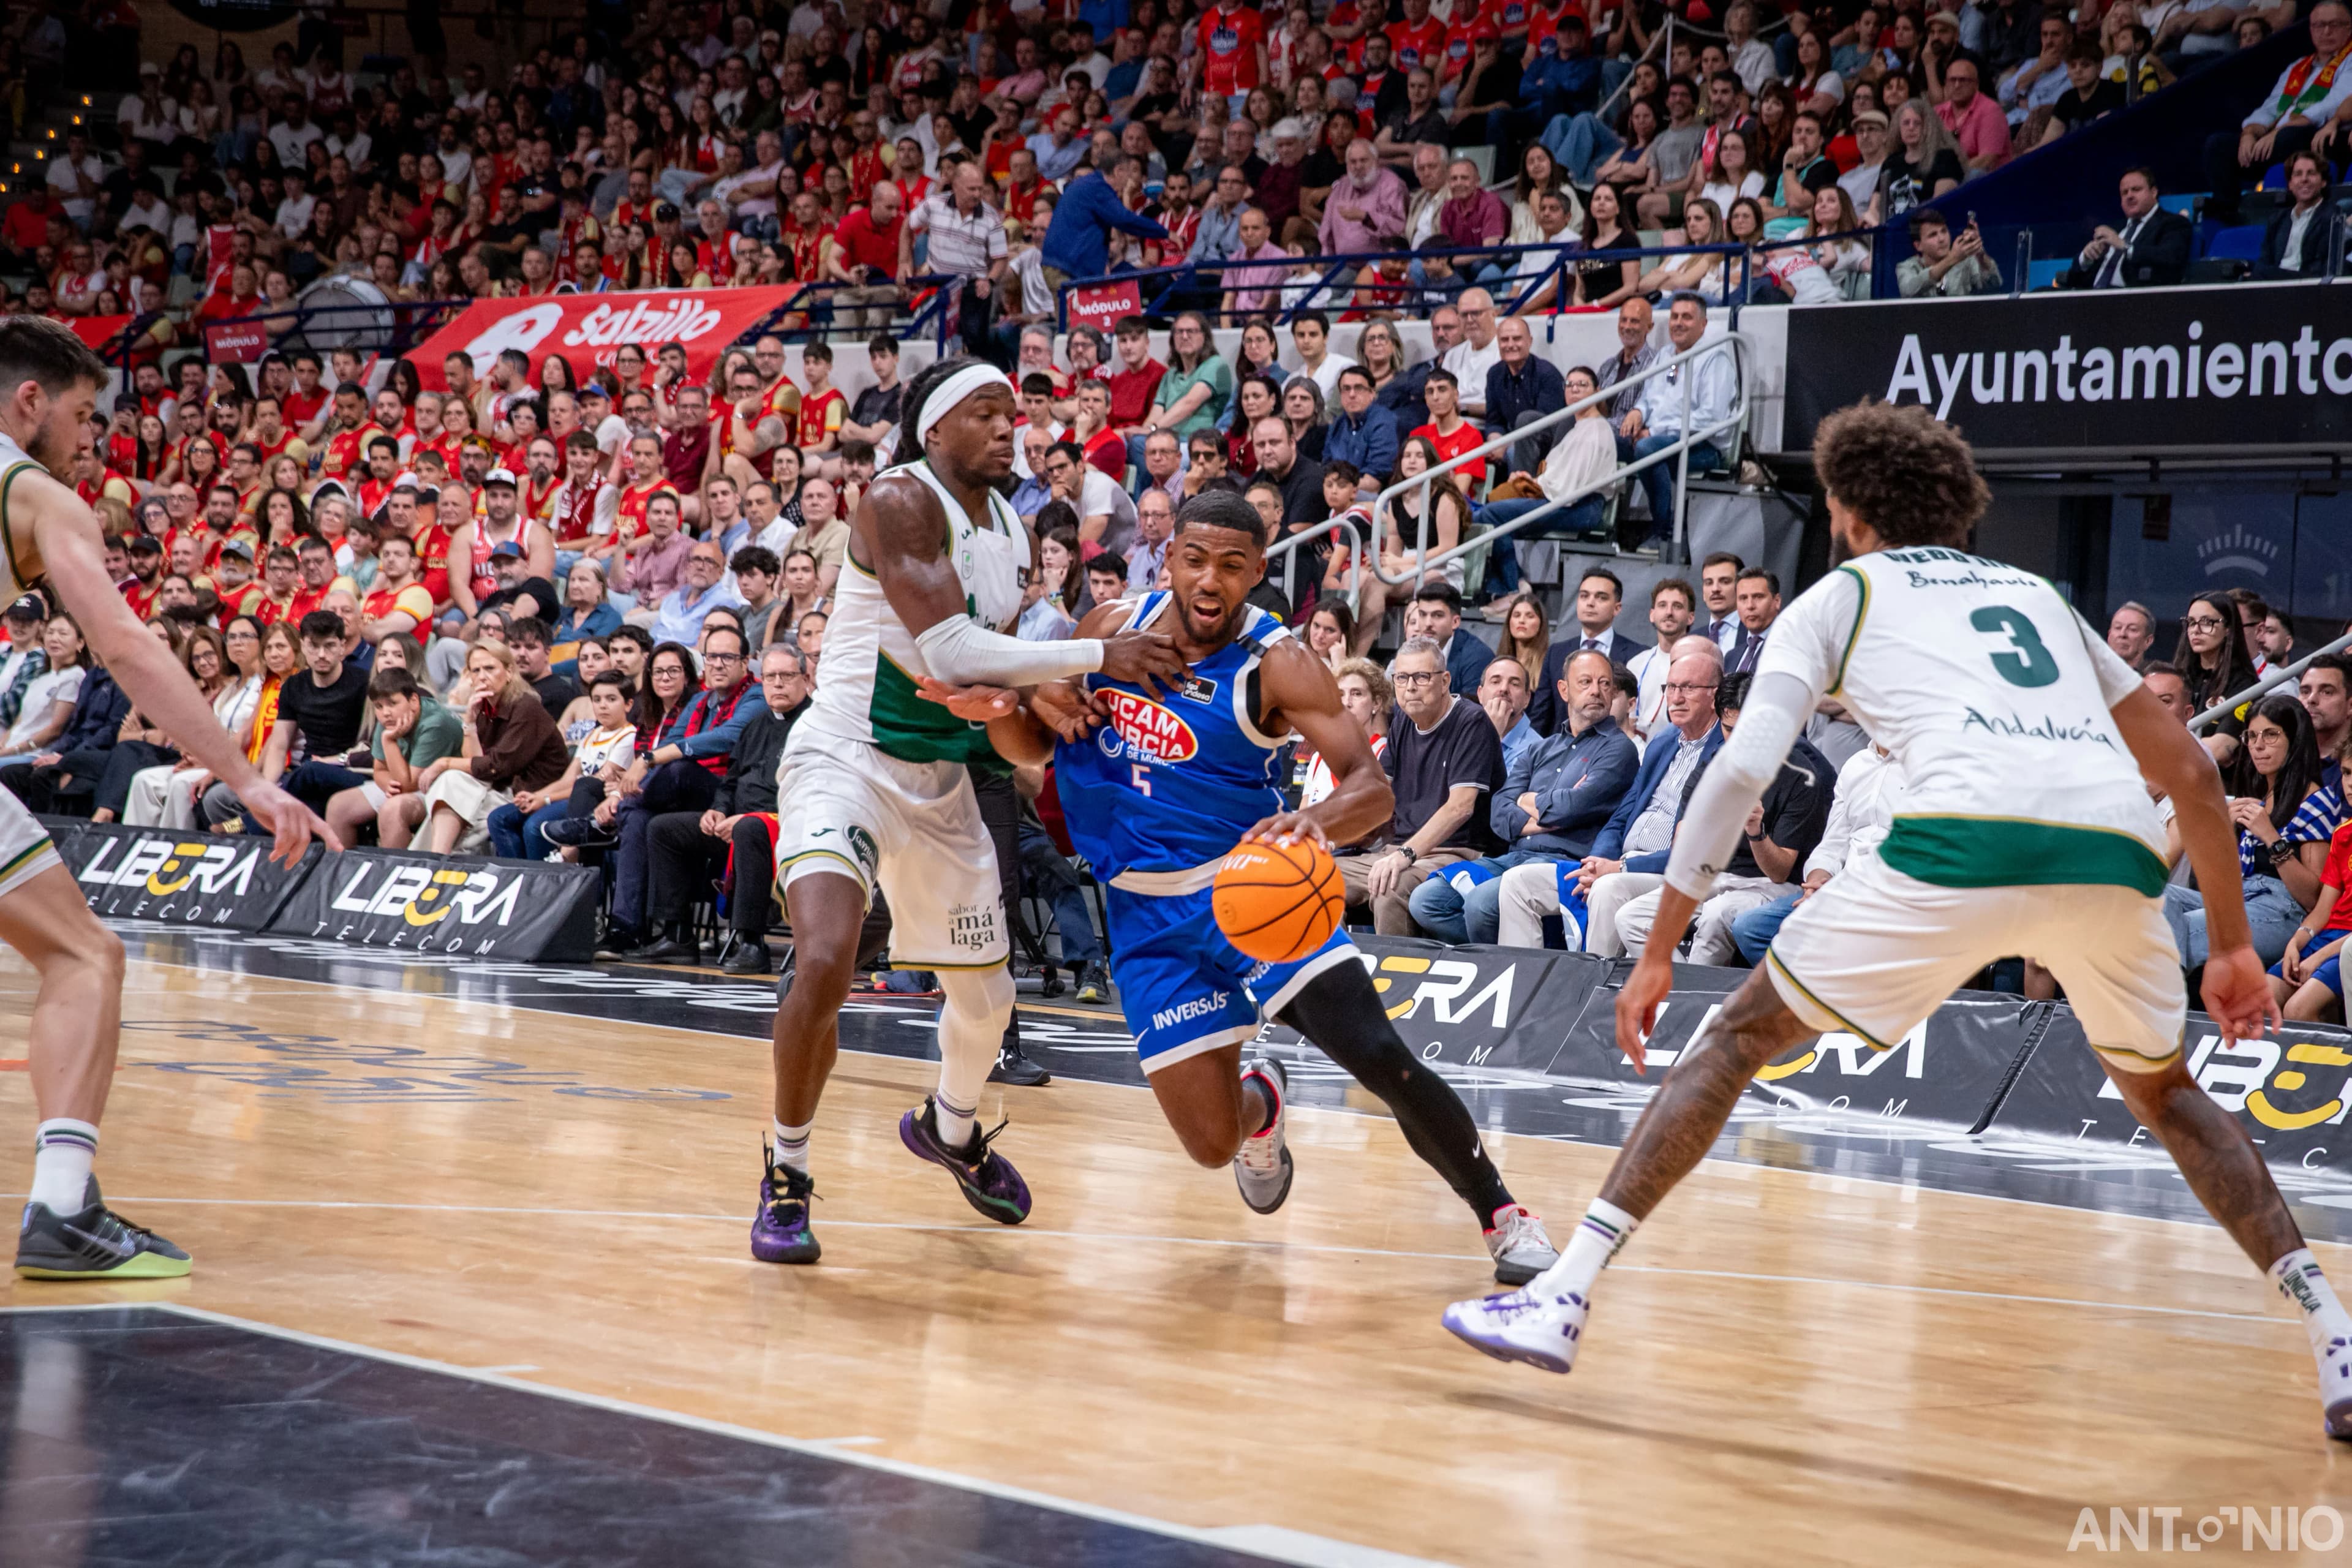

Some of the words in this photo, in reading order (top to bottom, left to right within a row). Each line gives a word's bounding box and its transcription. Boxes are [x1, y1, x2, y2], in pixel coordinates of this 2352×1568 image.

[563, 298, 722, 346] Salzillo
[1886, 320, 2352, 421] Ayuntamiento
[1970, 605, 2059, 688] 3
[1107, 692, 1180, 740] UCAM
[1131, 764, 1152, 797] 5
[78, 836, 260, 896] LIBERA
[86, 895, 233, 924] ELECOM
[331, 861, 524, 927] LIBERA
[948, 903, 979, 916] sabor
[956, 905, 993, 930] má
[311, 921, 496, 956] TELECOM
[951, 928, 995, 951] laga
